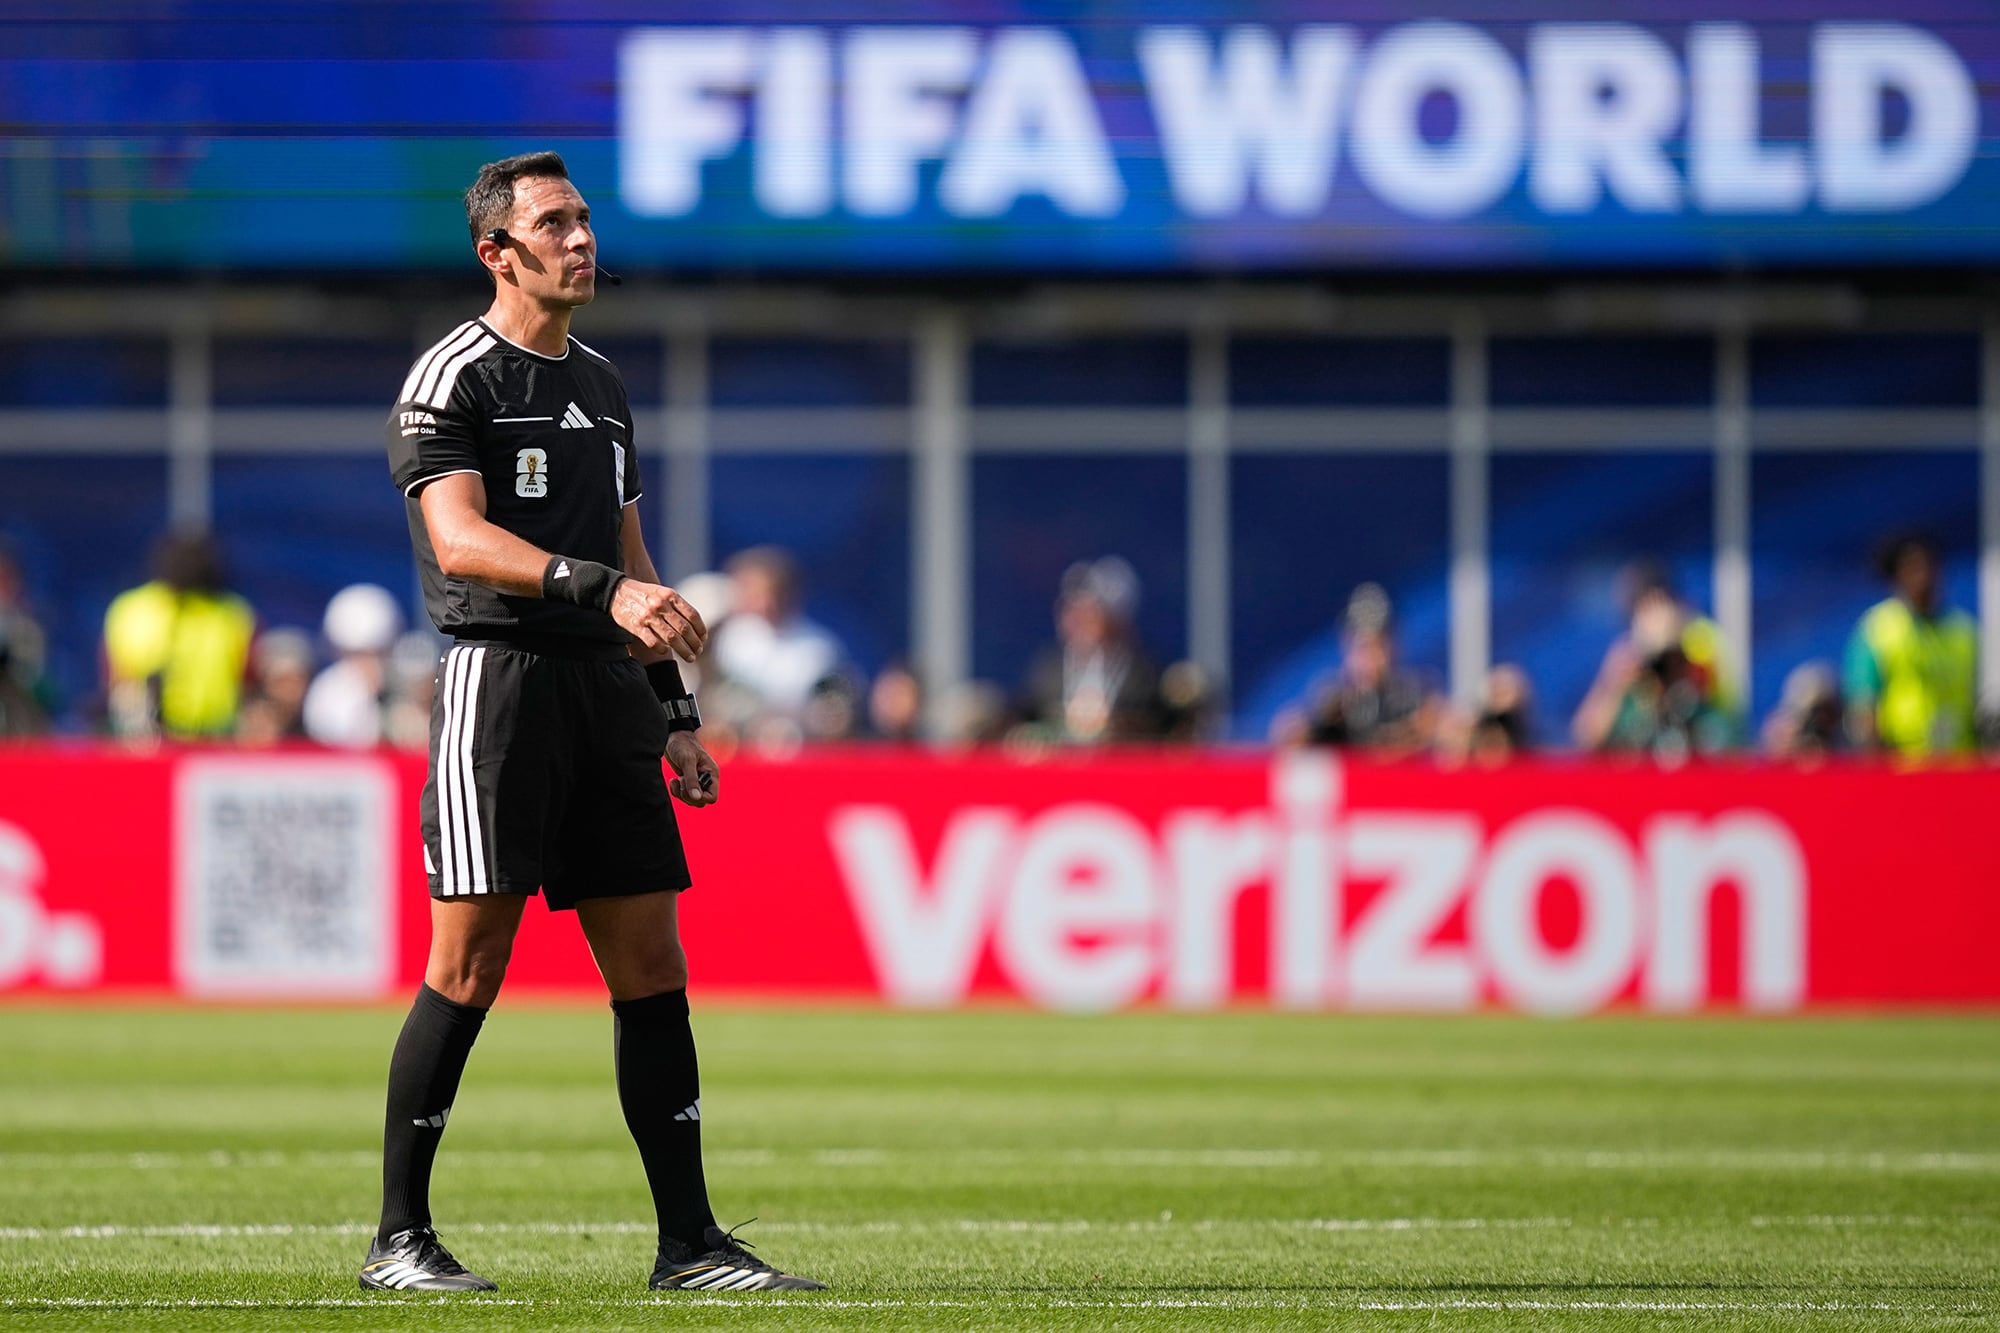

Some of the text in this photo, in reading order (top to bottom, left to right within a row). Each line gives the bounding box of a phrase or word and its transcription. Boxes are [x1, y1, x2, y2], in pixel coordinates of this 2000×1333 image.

[618, 22, 1978, 219] FIFA WORLD
[400, 411, 437, 427] FIFA
[829, 750, 1806, 1013] verizon
